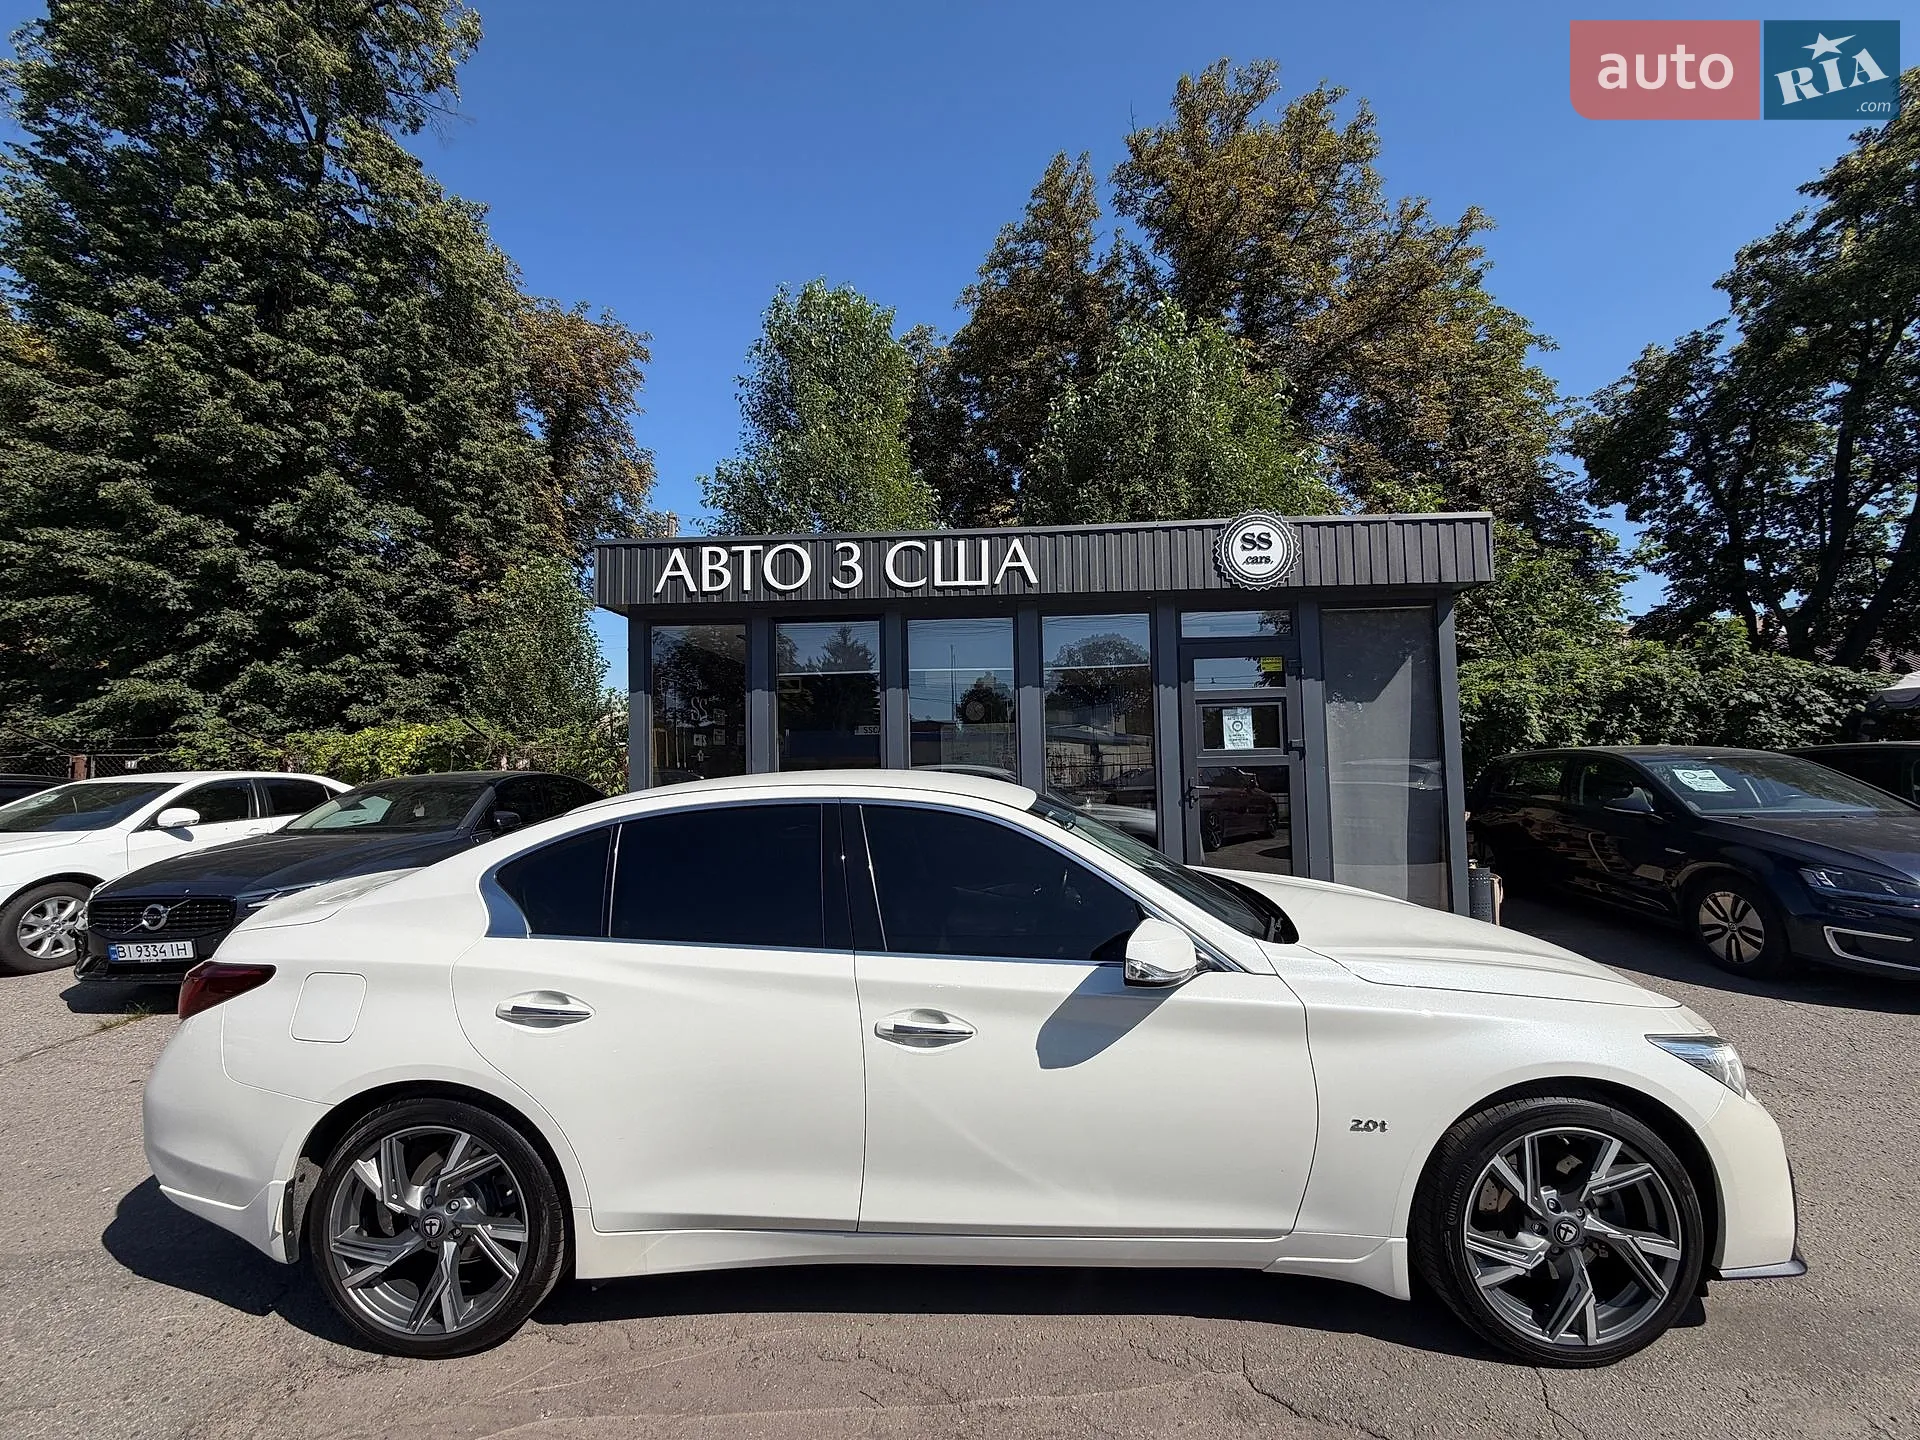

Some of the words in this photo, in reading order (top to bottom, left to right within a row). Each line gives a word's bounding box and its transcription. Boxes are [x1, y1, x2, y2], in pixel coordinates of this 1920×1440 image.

[1240, 532, 1273, 552] SS
[653, 543, 812, 595] АВТО
[831, 541, 864, 590] З
[885, 538, 1038, 589] США
[117, 944, 132, 958] BI
[135, 944, 167, 958] 9334
[170, 942, 188, 957] IH
